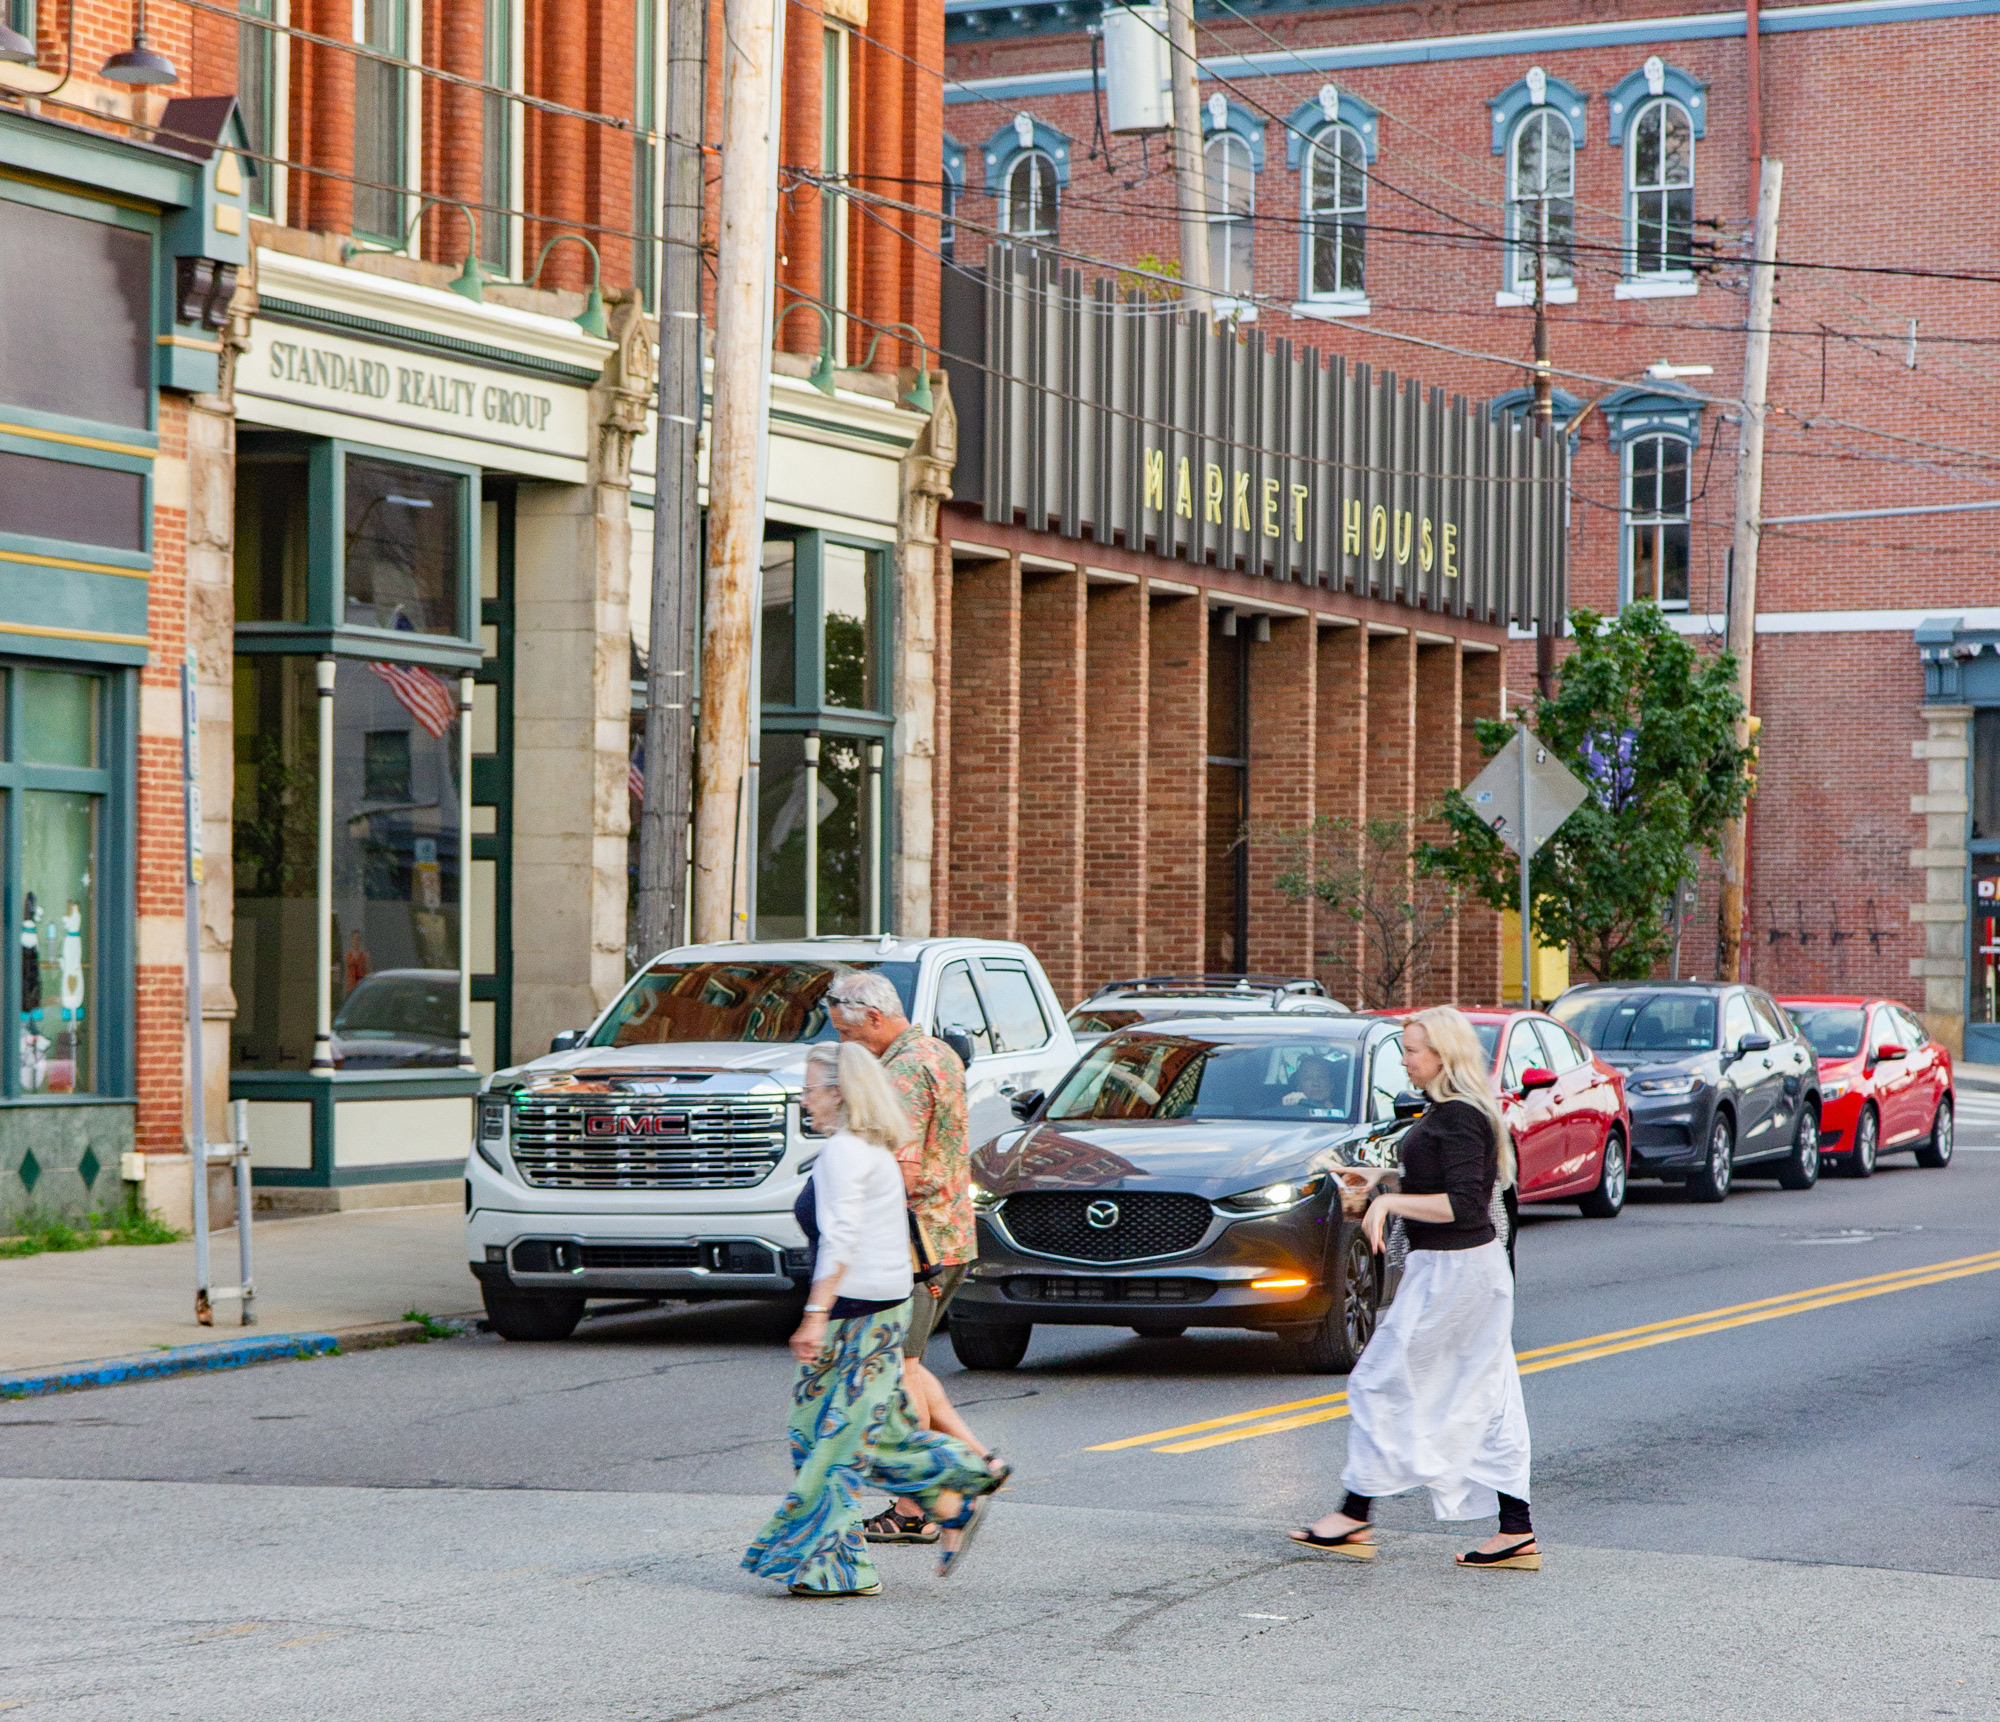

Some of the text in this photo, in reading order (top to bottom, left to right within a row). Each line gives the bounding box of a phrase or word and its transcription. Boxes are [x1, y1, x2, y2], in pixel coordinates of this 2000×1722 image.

[270, 340, 552, 432] STANDARD REALTY GROUP
[1143, 446, 1458, 578] MARKET HOUSE
[588, 1115, 685, 1135] GMC
